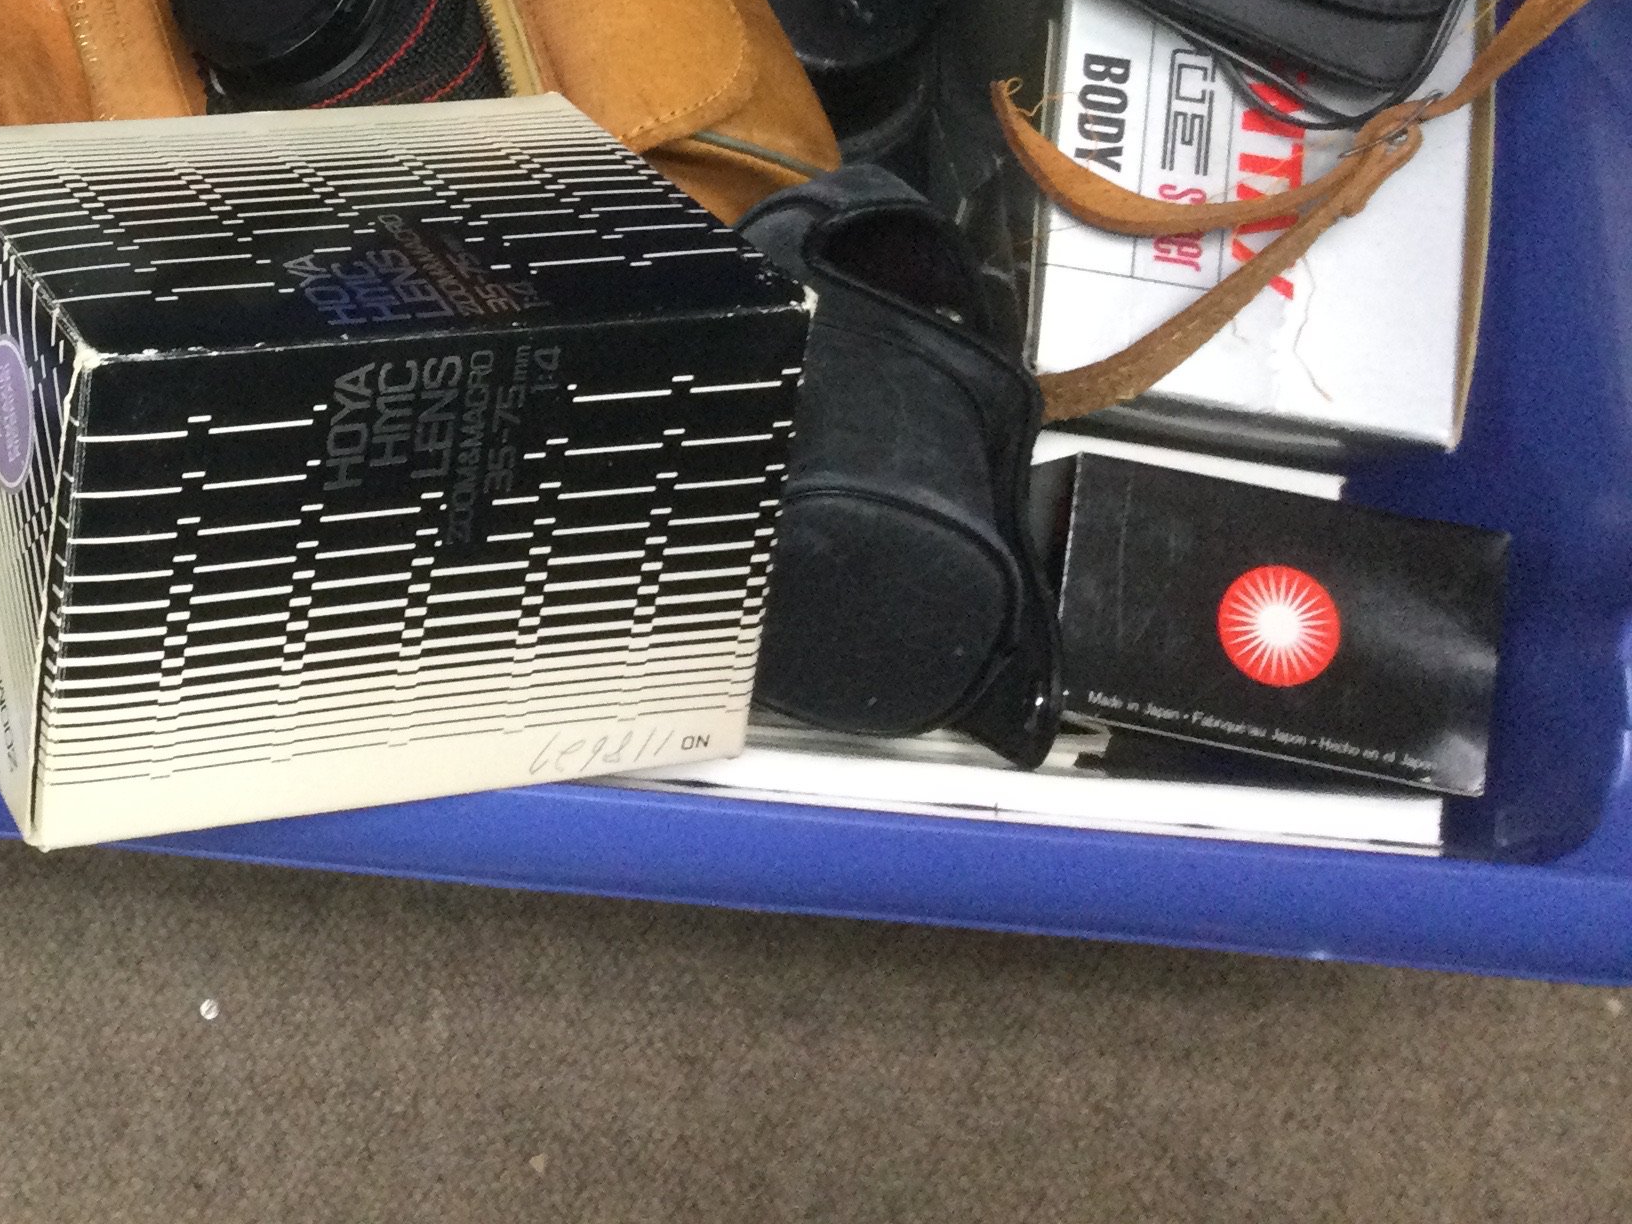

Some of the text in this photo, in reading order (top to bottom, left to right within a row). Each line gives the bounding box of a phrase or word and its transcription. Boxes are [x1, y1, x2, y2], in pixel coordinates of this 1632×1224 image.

[1073, 53, 1132, 173] BODY
[282, 254, 368, 326] HOYA
[330, 260, 412, 323] HMC
[366, 249, 455, 319] LENS
[323, 362, 376, 491] HOYA
[369, 359, 418, 468] HMC
[411, 354, 464, 479] LENS
[446, 349, 494, 545] ZOOM&MACRO
[680, 733, 711, 751] NO
[1088, 689, 1123, 710] Made
[1127, 700, 1139, 712] in
[1144, 702, 1180, 721] Japan
